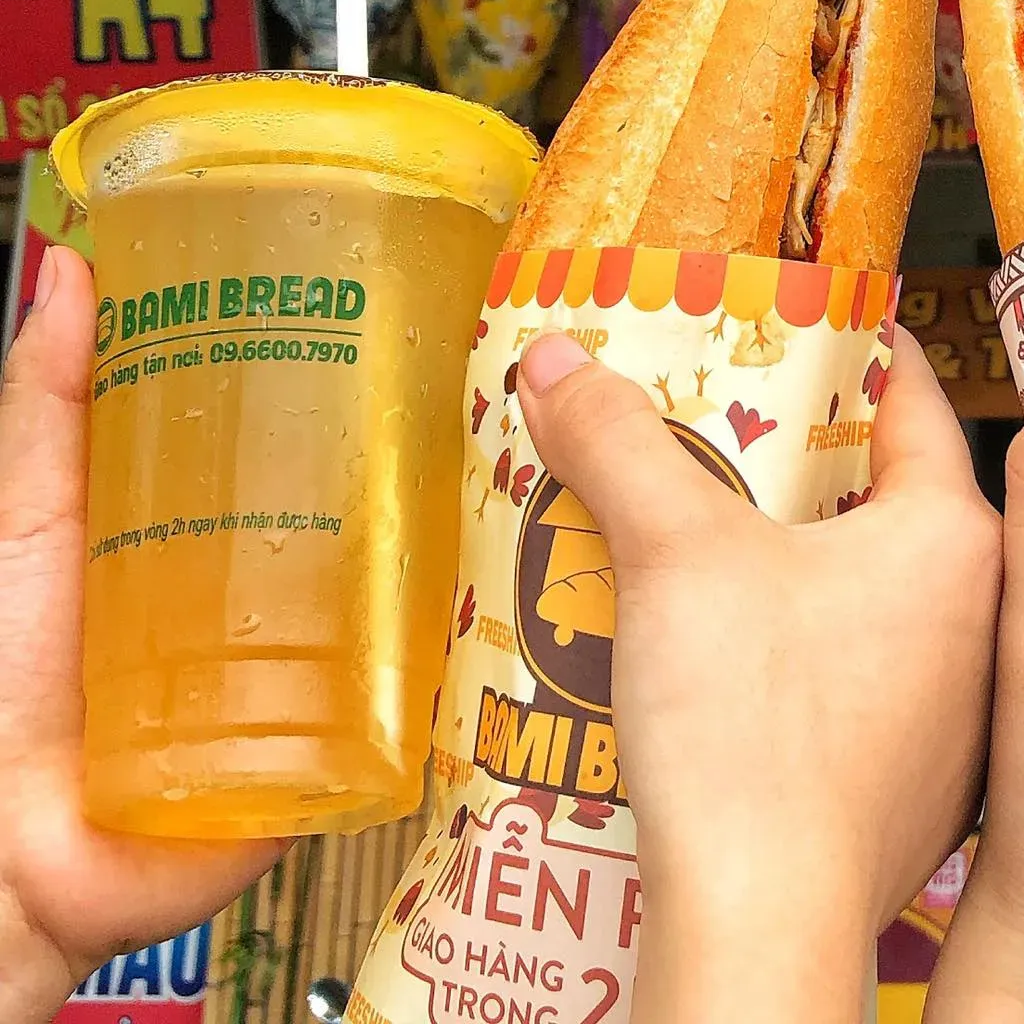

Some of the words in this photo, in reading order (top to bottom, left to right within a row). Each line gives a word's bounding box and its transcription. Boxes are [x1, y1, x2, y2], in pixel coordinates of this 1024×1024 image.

[121, 280, 210, 342] BAMI
[218, 275, 367, 321] BREAD
[110, 363, 139, 386] hàng
[143, 352, 167, 380] tận
[209, 338, 358, 365] 09.6600.7970
[805, 420, 874, 453] FREESHIP
[144, 522, 169, 542] vòng
[171, 517, 186, 536] 2h
[188, 517, 218, 537] ngay
[219, 511, 240, 530] khi
[241, 511, 274, 533] nhận
[277, 511, 309, 533] được
[311, 512, 342, 536] hàng
[474, 691, 574, 790] BAMI
[437, 820, 592, 942] MIỄN
[410, 916, 455, 965] GIAO
[464, 940, 565, 993] HÀNG
